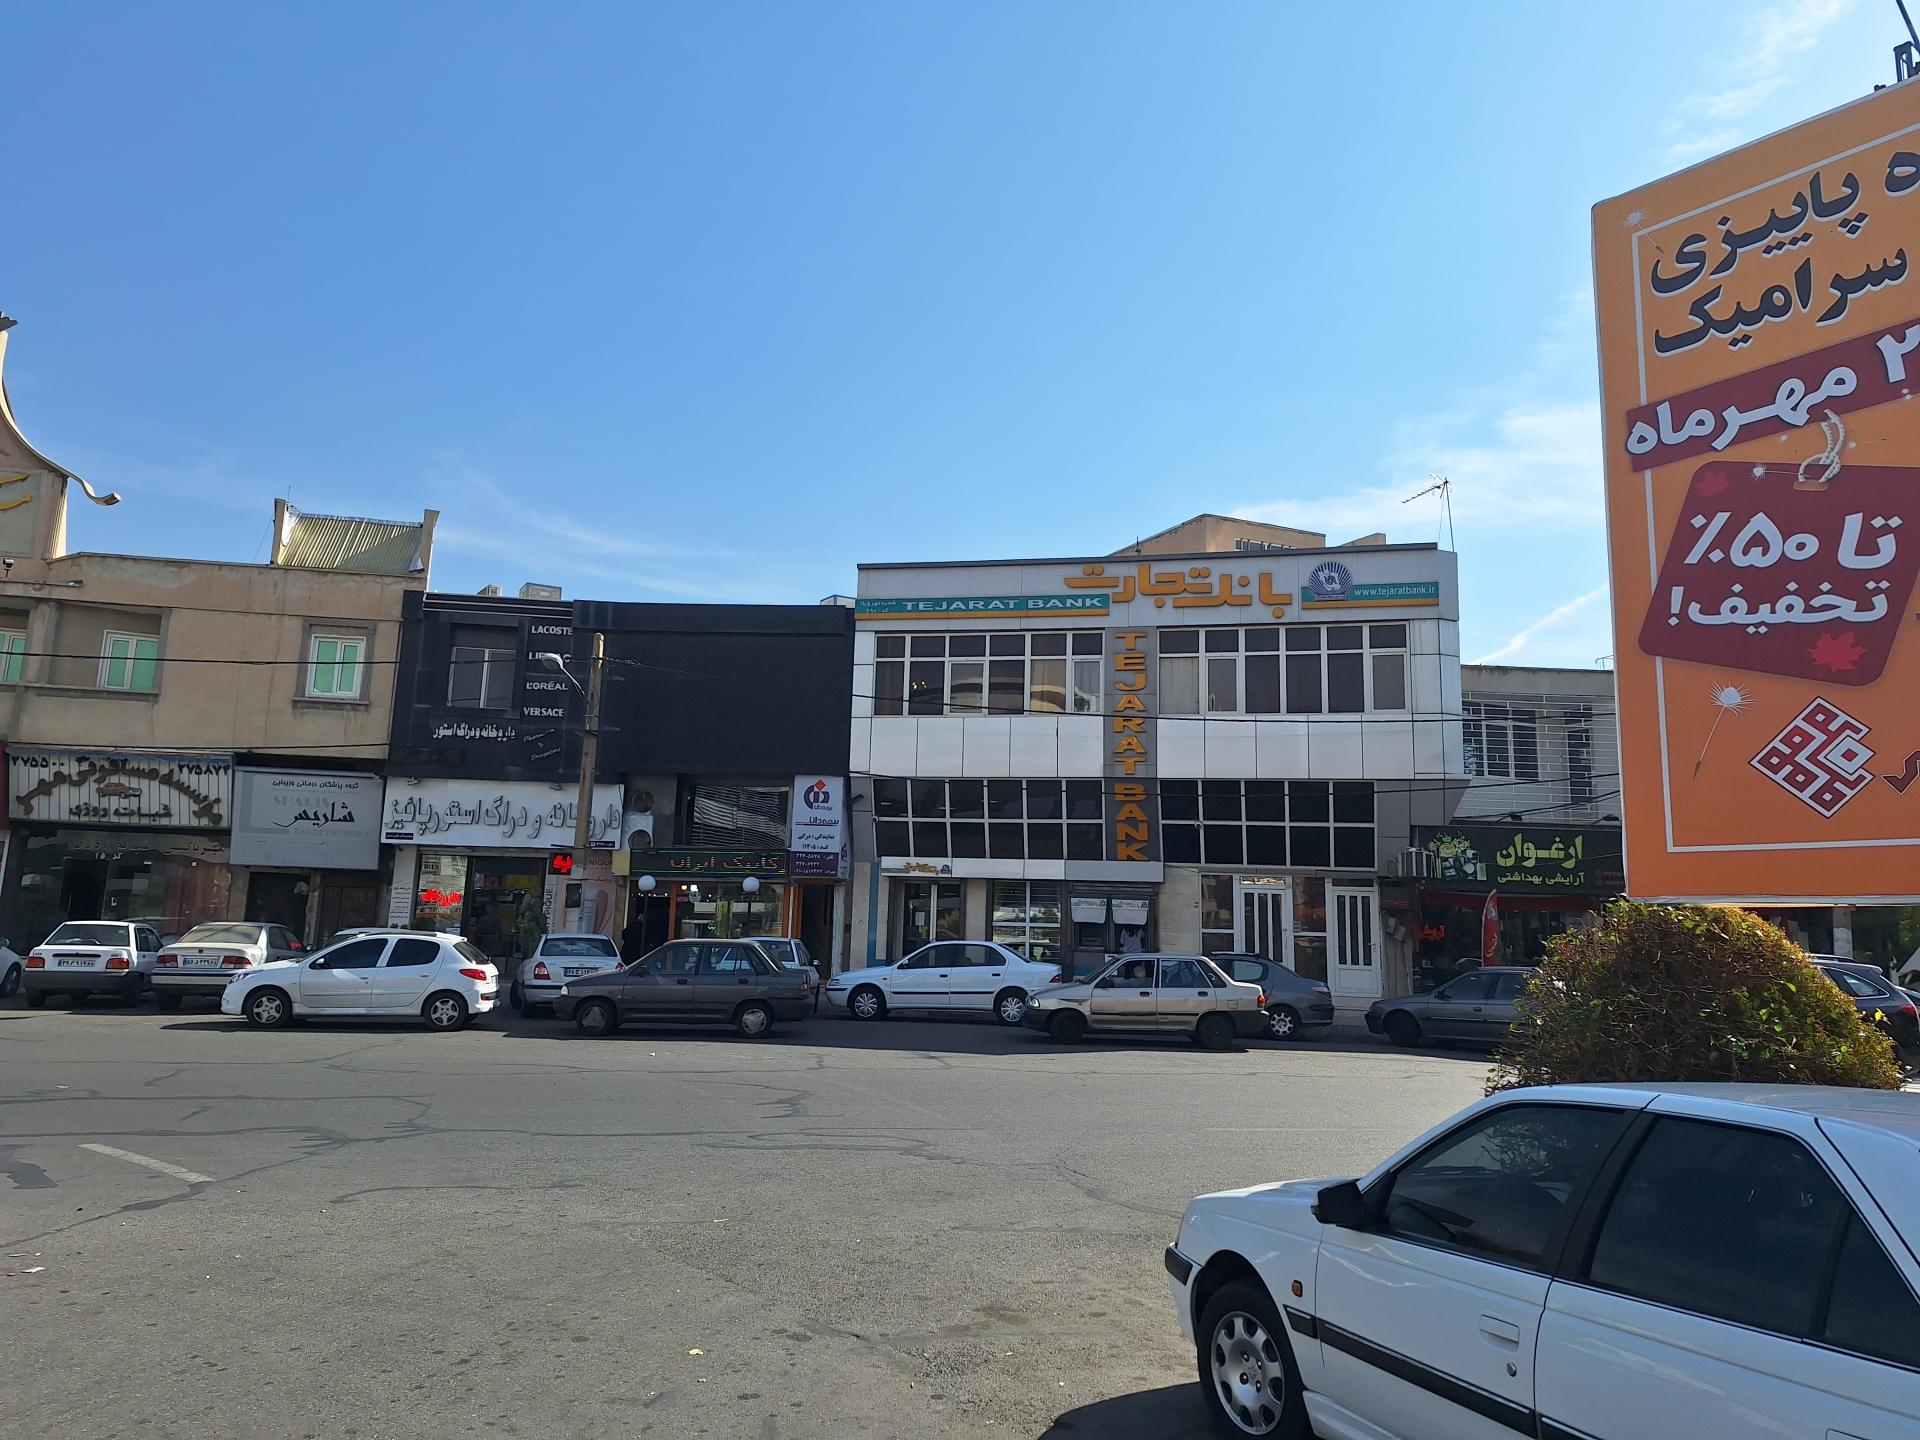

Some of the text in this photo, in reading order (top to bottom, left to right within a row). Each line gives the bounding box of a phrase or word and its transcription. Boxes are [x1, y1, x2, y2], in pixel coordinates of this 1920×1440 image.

[1650, 171, 1869, 297] پاییزی
[1654, 247, 1908, 355] سرامیک
[1626, 365, 1858, 455] مهرماه
[1837, 511, 1904, 570] تا
[1063, 563, 1292, 618] بانک تجارت
[1354, 584, 1436, 598] www.tejaratbank.ir
[902, 597, 1104, 612] TEJARAT BANK
[531, 625, 573, 636] LACOSTE
[528, 651, 572, 663] LIEC
[523, 706, 565, 718] VERSACE
[1112, 630, 1149, 776] TEJARAT
[432, 723, 457, 739] استور
[456, 722, 475, 740] دراگ
[480, 724, 516, 742] داروخانه
[345, 781, 360, 790] گروه
[113, 802, 173, 822] شبانه
[272, 801, 355, 829] شاریس
[484, 794, 528, 839] دراگ
[545, 800, 620, 841] داروانه
[1115, 783, 1149, 862] BANK
[1495, 832, 1583, 869] ارغوان
[1497, 871, 1543, 885] بهداشتی
[1545, 872, 1585, 886] آرایشی
